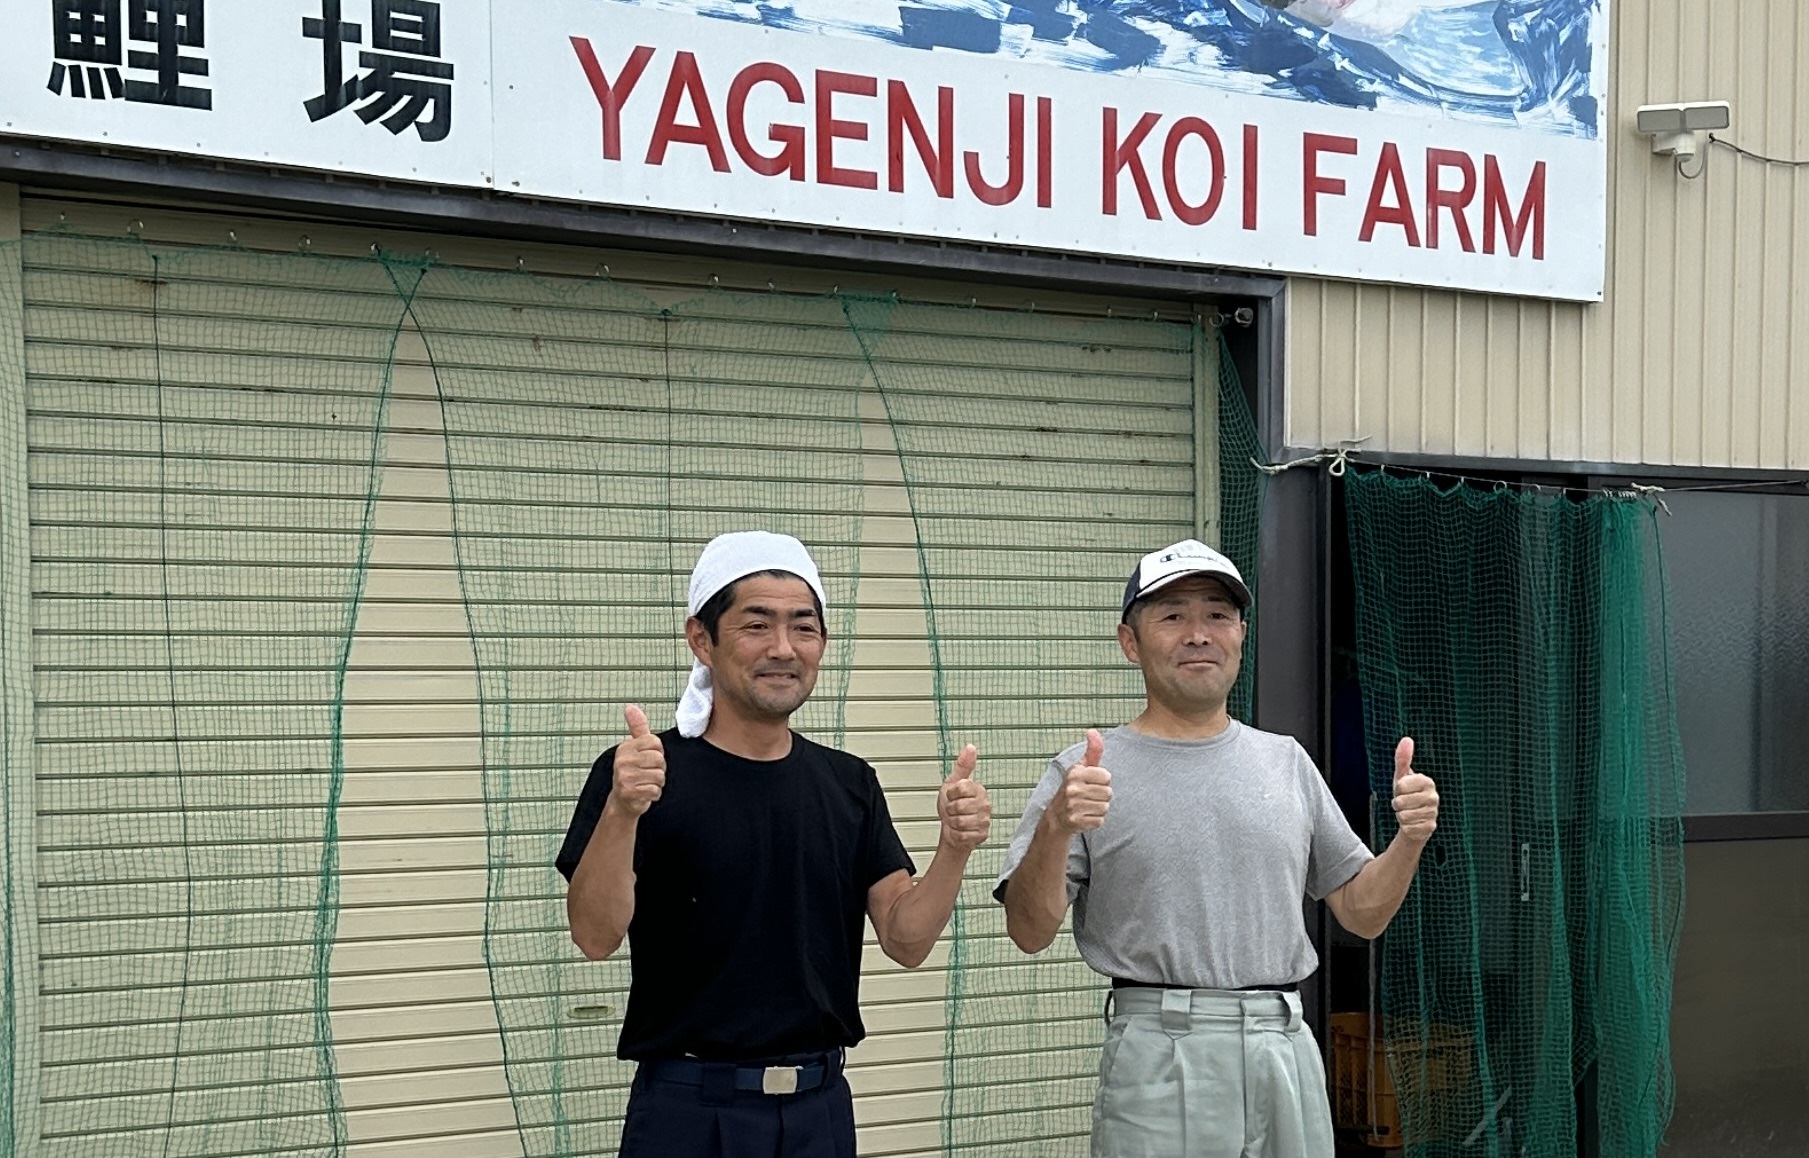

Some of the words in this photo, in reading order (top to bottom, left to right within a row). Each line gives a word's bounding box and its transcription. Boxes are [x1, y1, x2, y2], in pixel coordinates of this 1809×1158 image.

[570, 37, 1053, 209] YAGENJI
[1103, 108, 1258, 231] KOI
[1304, 132, 1545, 261] FARM
